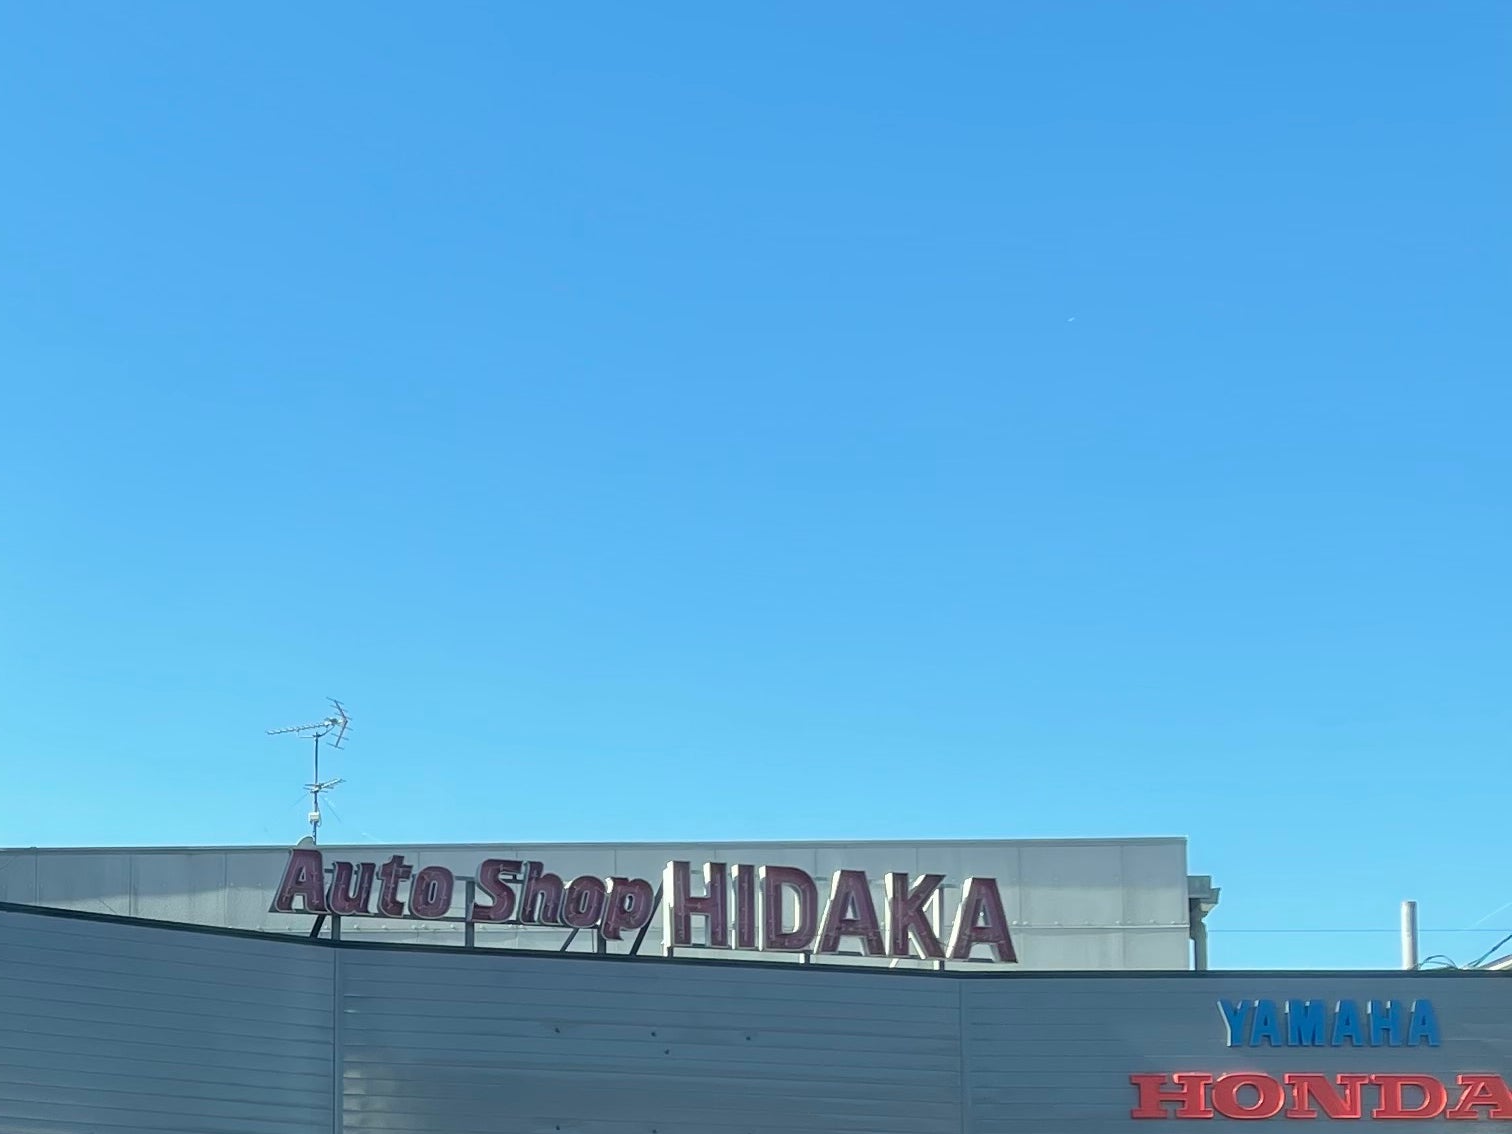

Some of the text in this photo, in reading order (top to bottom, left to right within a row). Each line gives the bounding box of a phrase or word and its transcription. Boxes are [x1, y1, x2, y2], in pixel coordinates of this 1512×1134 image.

[269, 848, 1018, 964] Auto Shop HIDAKA
[1216, 1000, 1440, 1047] YAMAHA
[1130, 1072, 1512, 1121] HONDA
